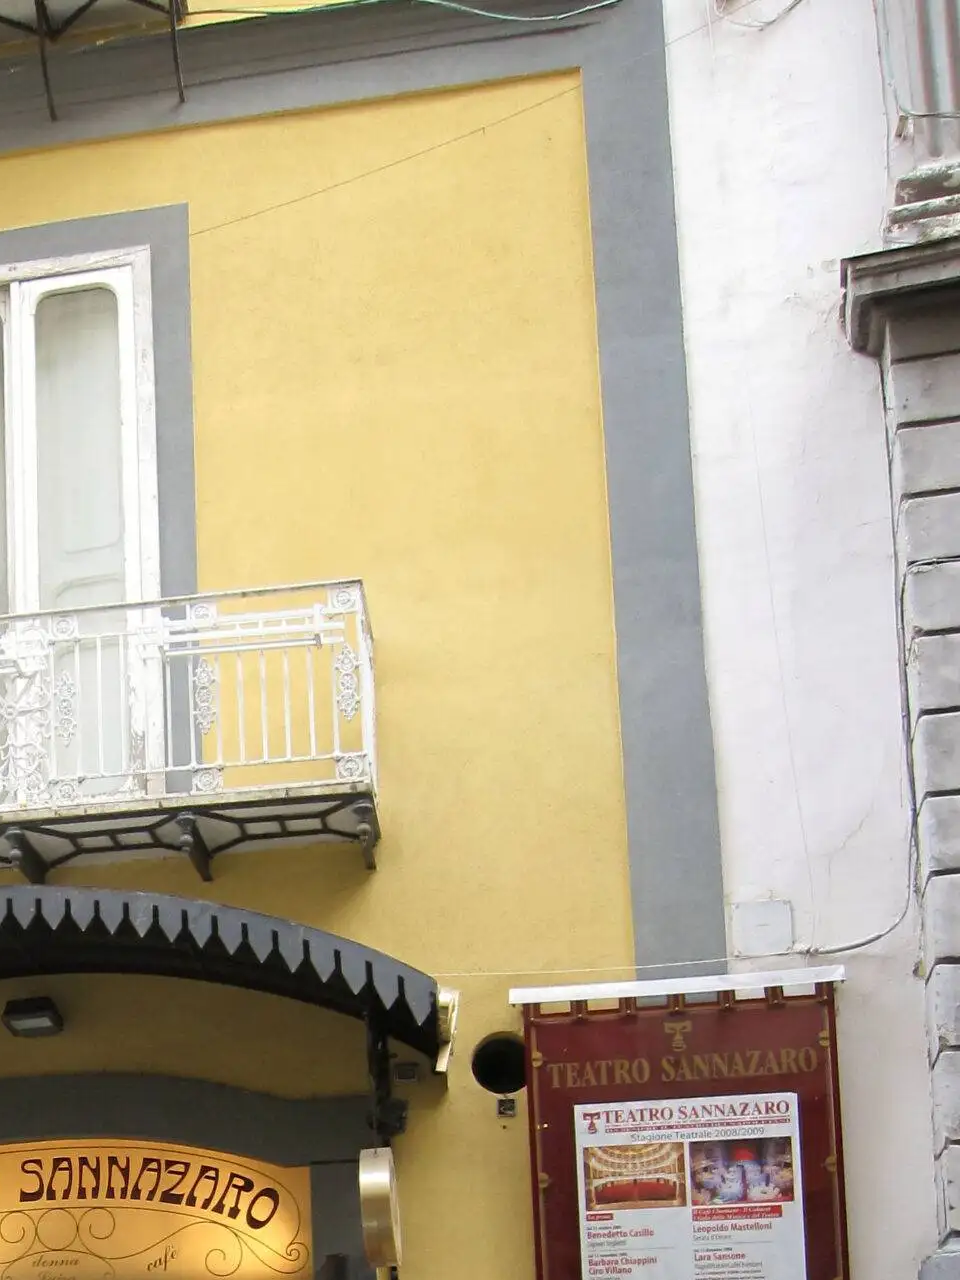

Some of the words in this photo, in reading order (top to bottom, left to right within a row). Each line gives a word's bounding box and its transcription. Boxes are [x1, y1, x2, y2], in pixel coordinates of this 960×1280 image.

[548, 1057, 651, 1089] TEATRO
[662, 1046, 819, 1082] SANNAZARO
[602, 1106, 673, 1124] TEATRO
[678, 1099, 790, 1120] SANNAZARO
[631, 1132, 673, 1143] Stagione
[675, 1129, 711, 1140] Teatrale
[714, 1126, 765, 1138] 2008/2009
[19, 1155, 280, 1230] SANNAZARO
[587, 1230, 628, 1239] Benedetto
[629, 1228, 655, 1238] Casillo
[693, 1224, 729, 1234] Leopoldo
[731, 1222, 772, 1232] Mastelloni
[32, 1252, 80, 1268] donna
[605, 1267, 632, 1275] Villano
